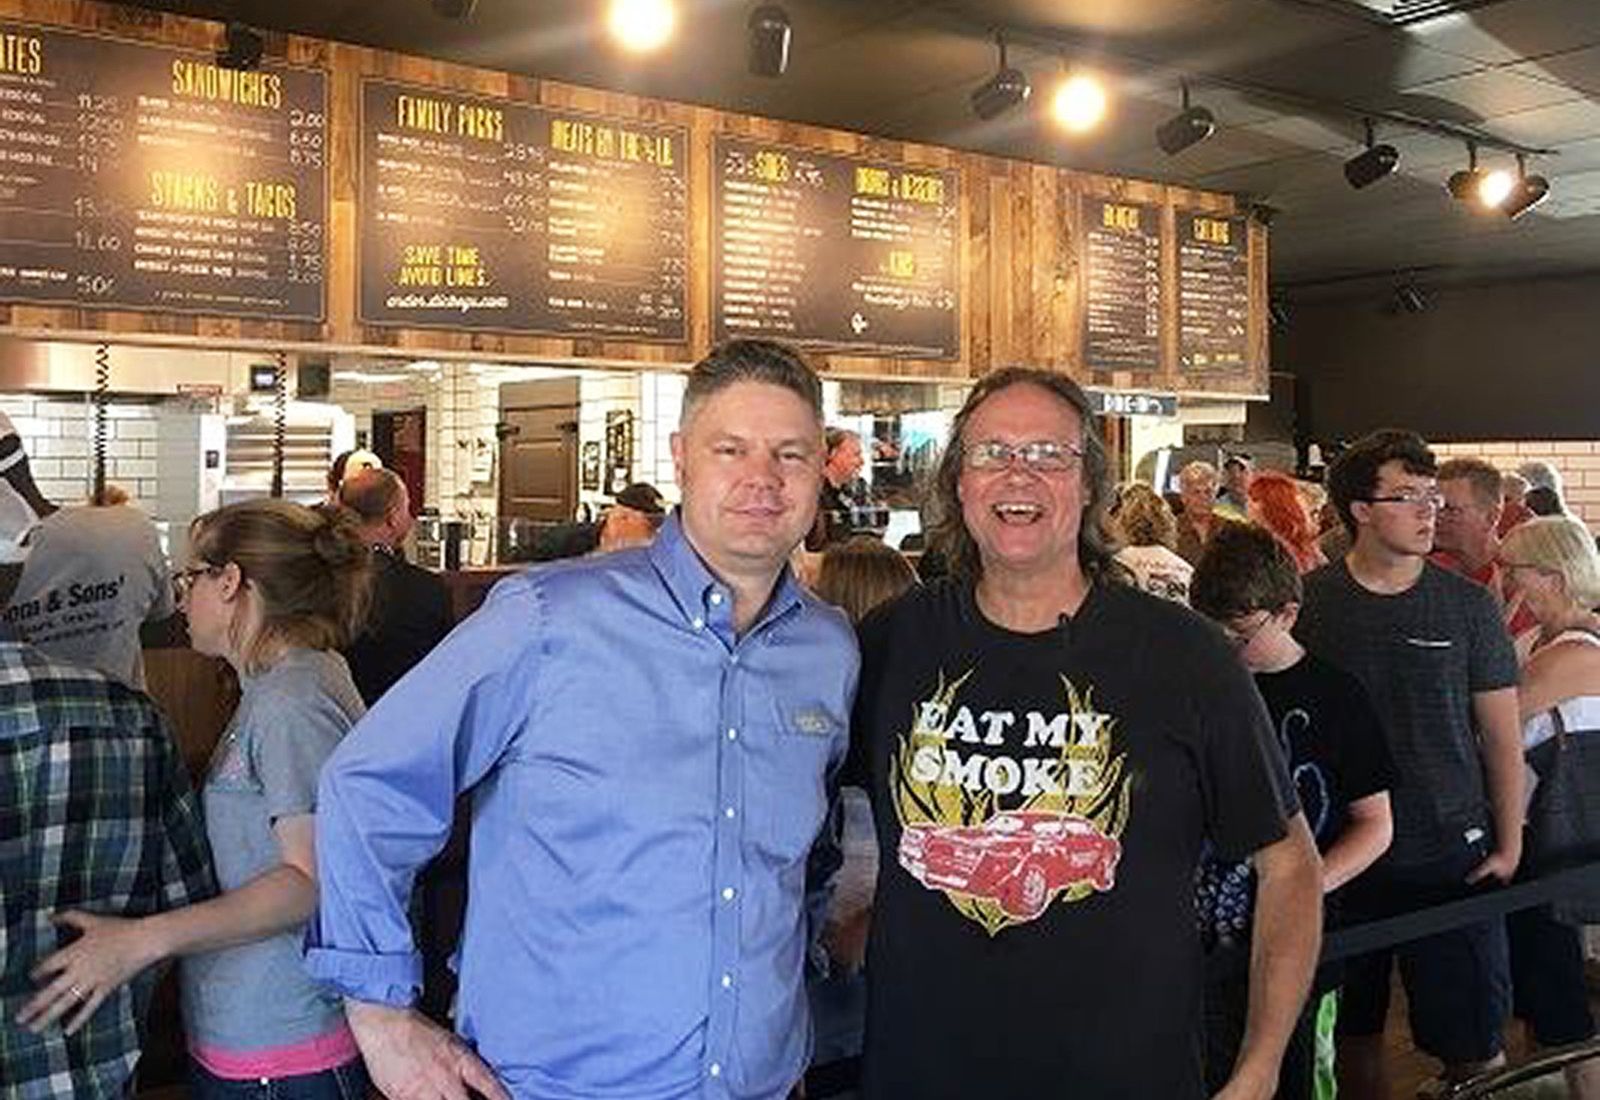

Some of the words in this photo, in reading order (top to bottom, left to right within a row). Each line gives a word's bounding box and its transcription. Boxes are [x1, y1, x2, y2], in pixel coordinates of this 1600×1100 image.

[172, 59, 282, 110] SANDWICHES
[398, 95, 451, 134] FAMILY
[47, 590, 61, 614] &
[920, 701, 1016, 746] EAT
[1022, 710, 1111, 748] MY
[910, 750, 1105, 797] SMOKE
